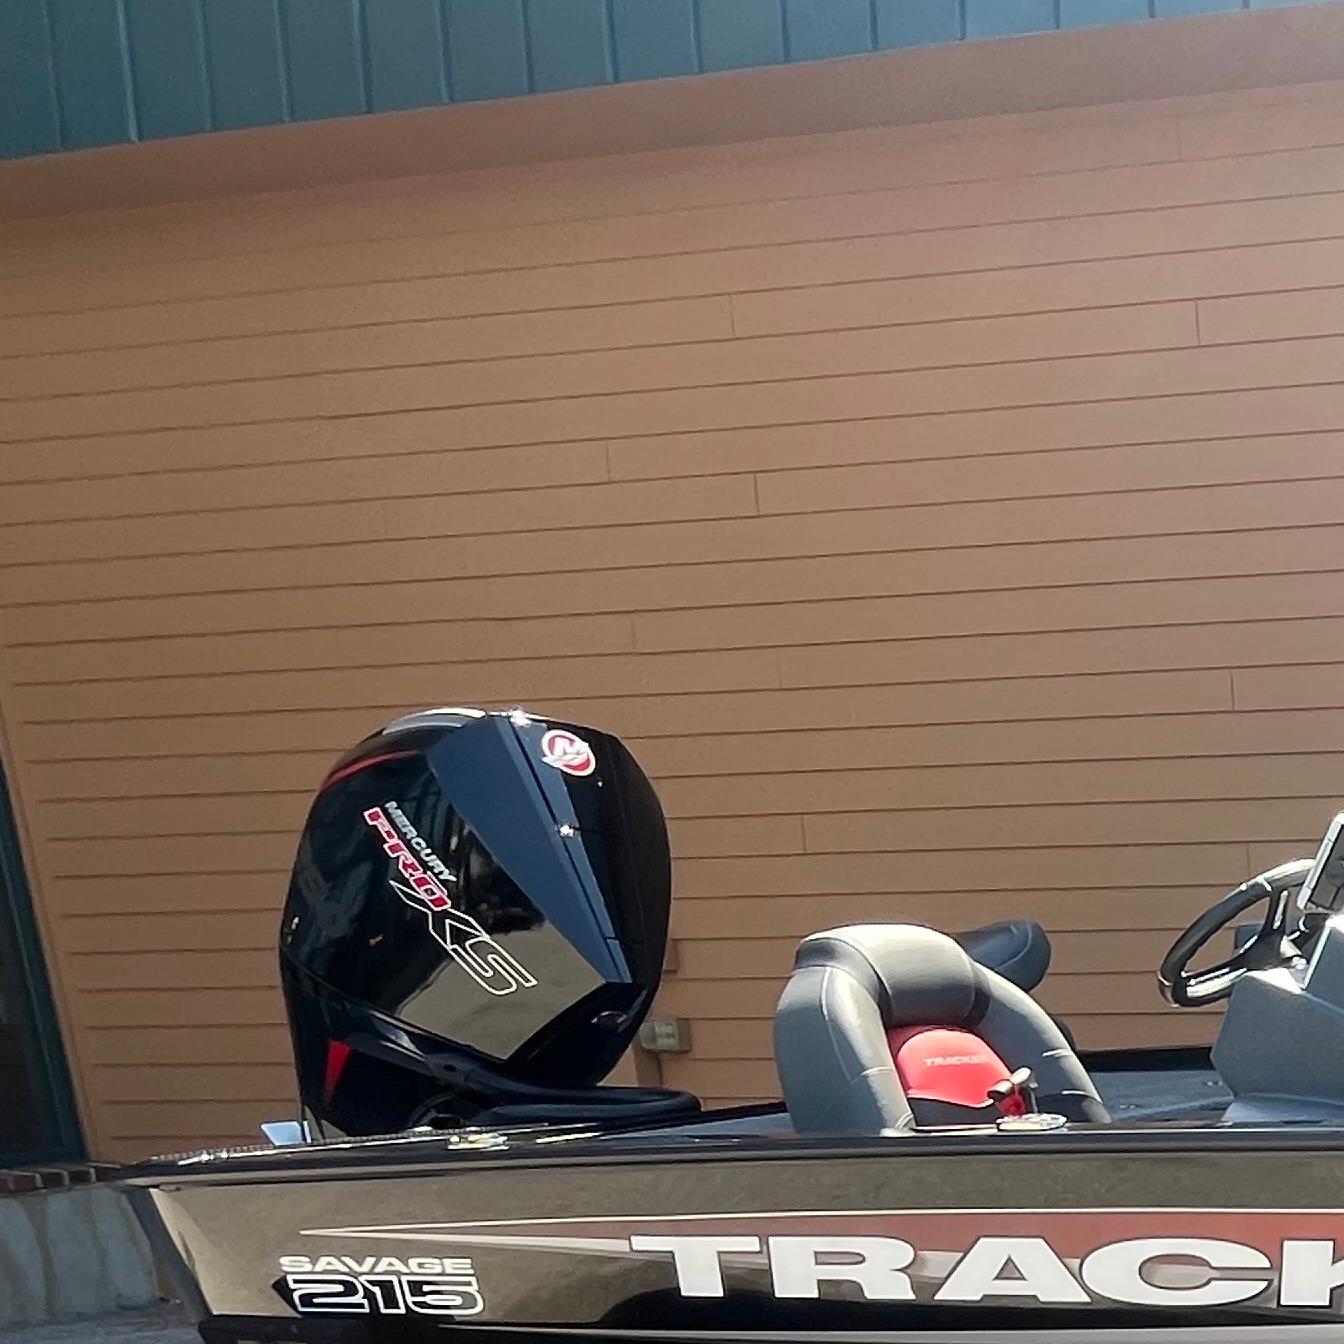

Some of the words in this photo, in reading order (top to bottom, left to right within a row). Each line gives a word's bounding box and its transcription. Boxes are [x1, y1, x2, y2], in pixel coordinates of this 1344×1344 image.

[363, 807, 452, 911] PRO
[384, 801, 458, 882] MERCURY
[389, 878, 538, 995] XS
[278, 1255, 476, 1274] SAVAGE
[286, 1273, 484, 1316] 215
